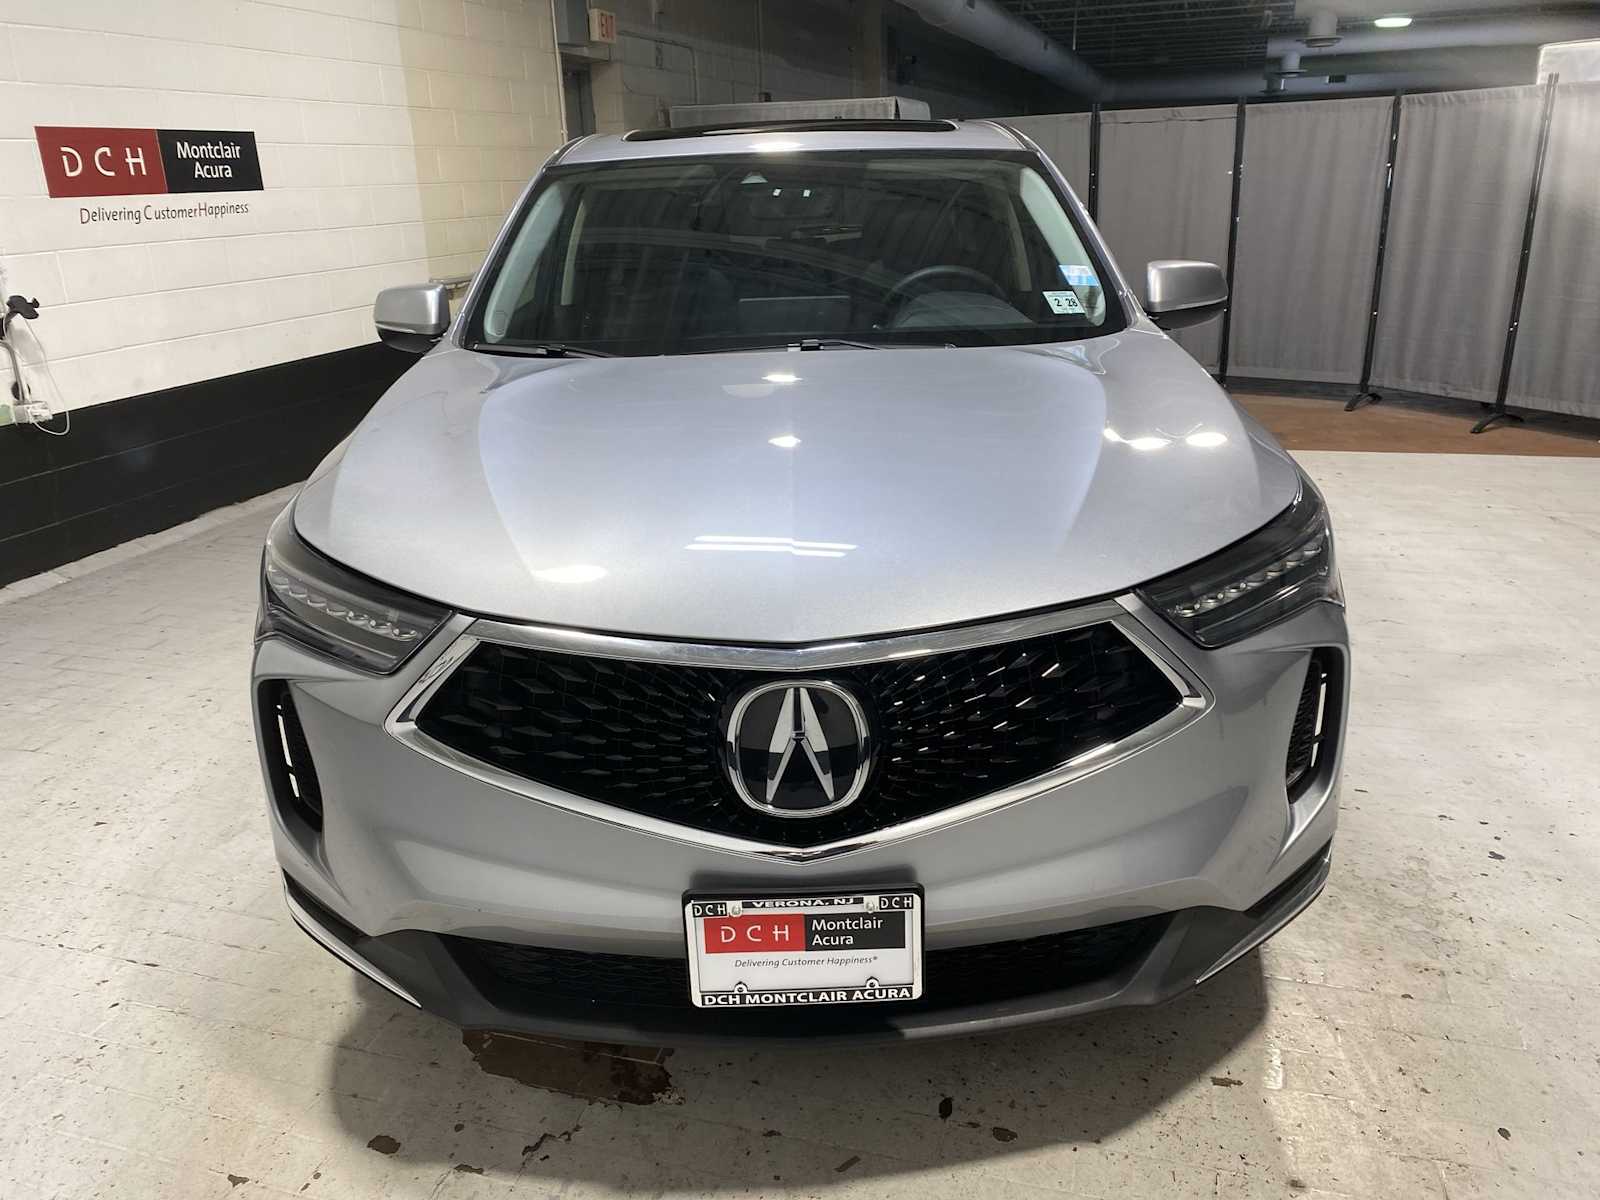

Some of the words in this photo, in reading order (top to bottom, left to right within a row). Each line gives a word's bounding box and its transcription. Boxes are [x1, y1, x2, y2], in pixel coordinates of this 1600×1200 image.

[176, 141, 241, 159] Montclair
[60, 146, 147, 177] DCH
[194, 162, 233, 178] Acura
[80, 206, 141, 225] Delivering
[199, 202, 249, 217] Happiness
[1054, 298, 1062, 307] 2
[693, 904, 727, 916] DCH
[880, 896, 913, 909] DCH
[811, 917, 883, 931] Montclair
[721, 925, 790, 943] DCH
[811, 932, 854, 946] Acura
[734, 959, 780, 968] Delivering
[781, 957, 825, 967] Customer
[704, 995, 740, 1006] DCH
[745, 991, 848, 1004] MONTCLAIR
[852, 988, 911, 1000] ACURA
